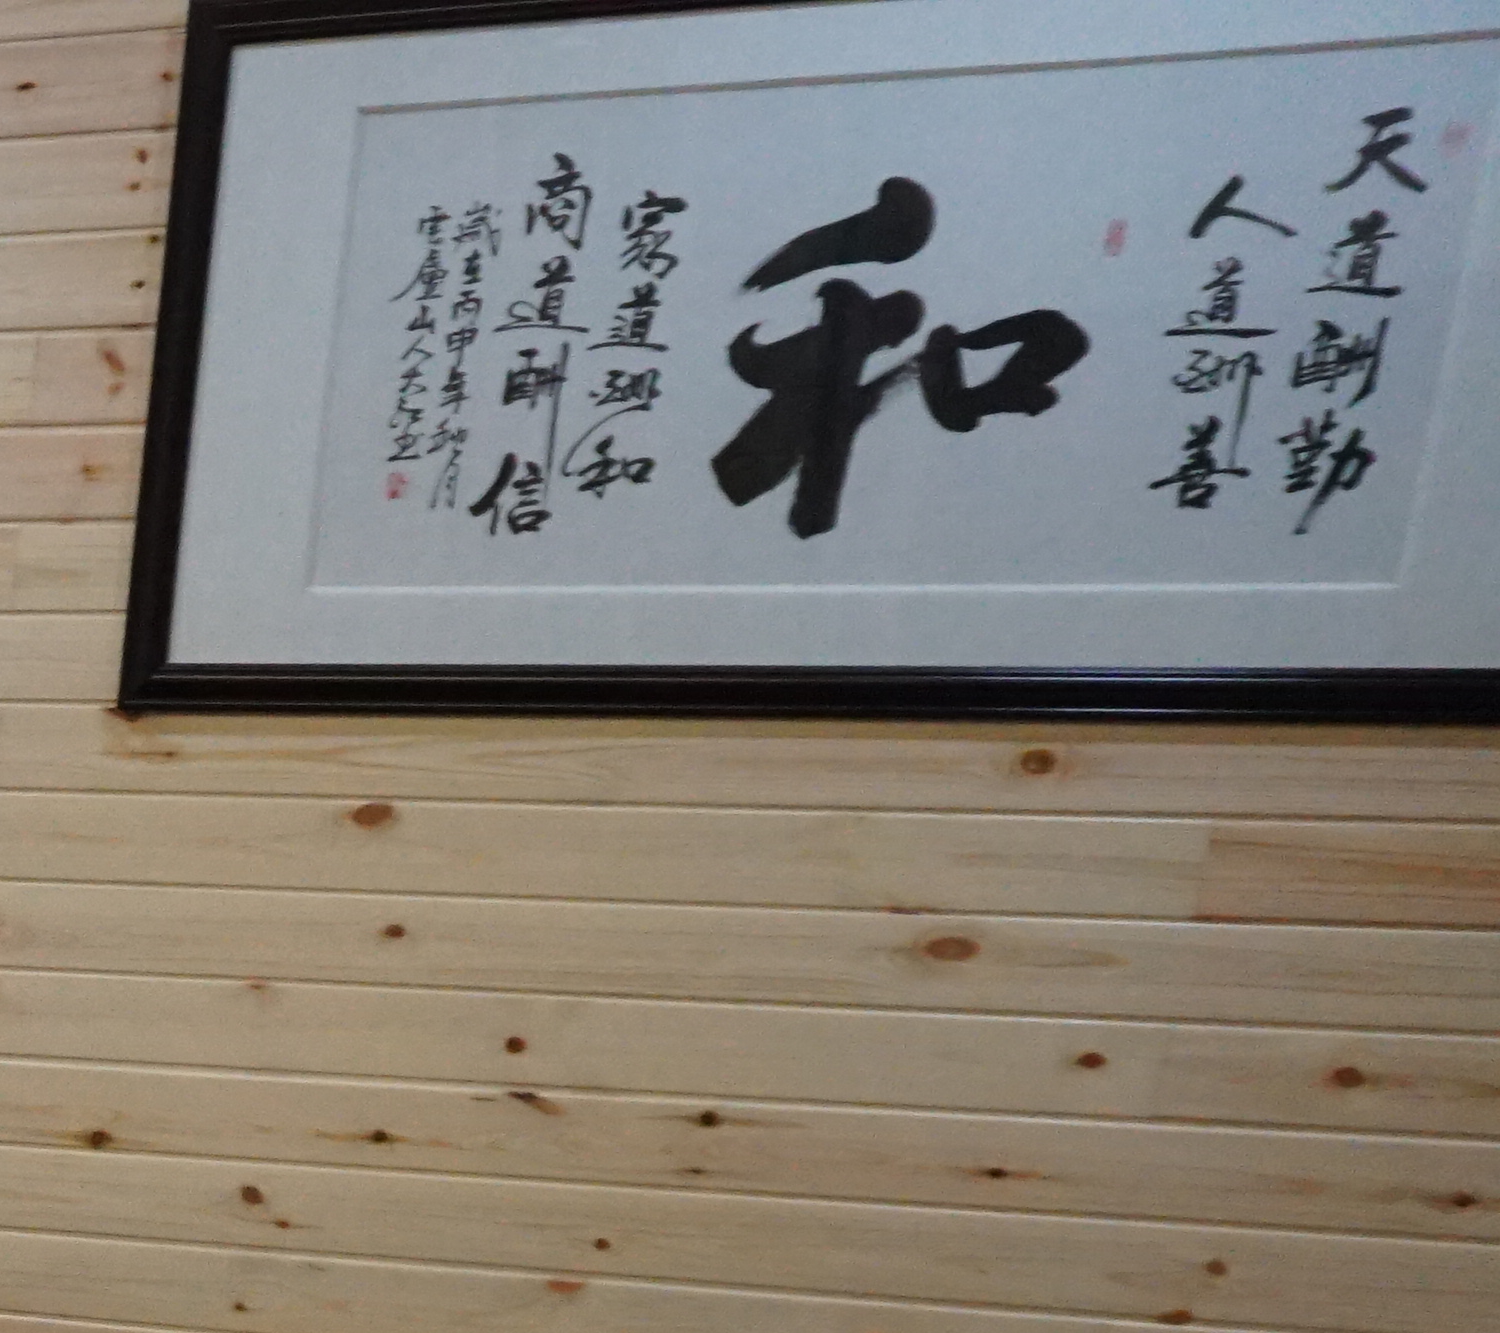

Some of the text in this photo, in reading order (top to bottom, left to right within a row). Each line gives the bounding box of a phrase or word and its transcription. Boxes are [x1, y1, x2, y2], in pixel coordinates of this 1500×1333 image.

[469, 151, 593, 536] 商道酬信
[710, 176, 1092, 540] 和
[1149, 174, 1298, 508] 人道酬善
[1278, 106, 1428, 535] 天道酬勤
